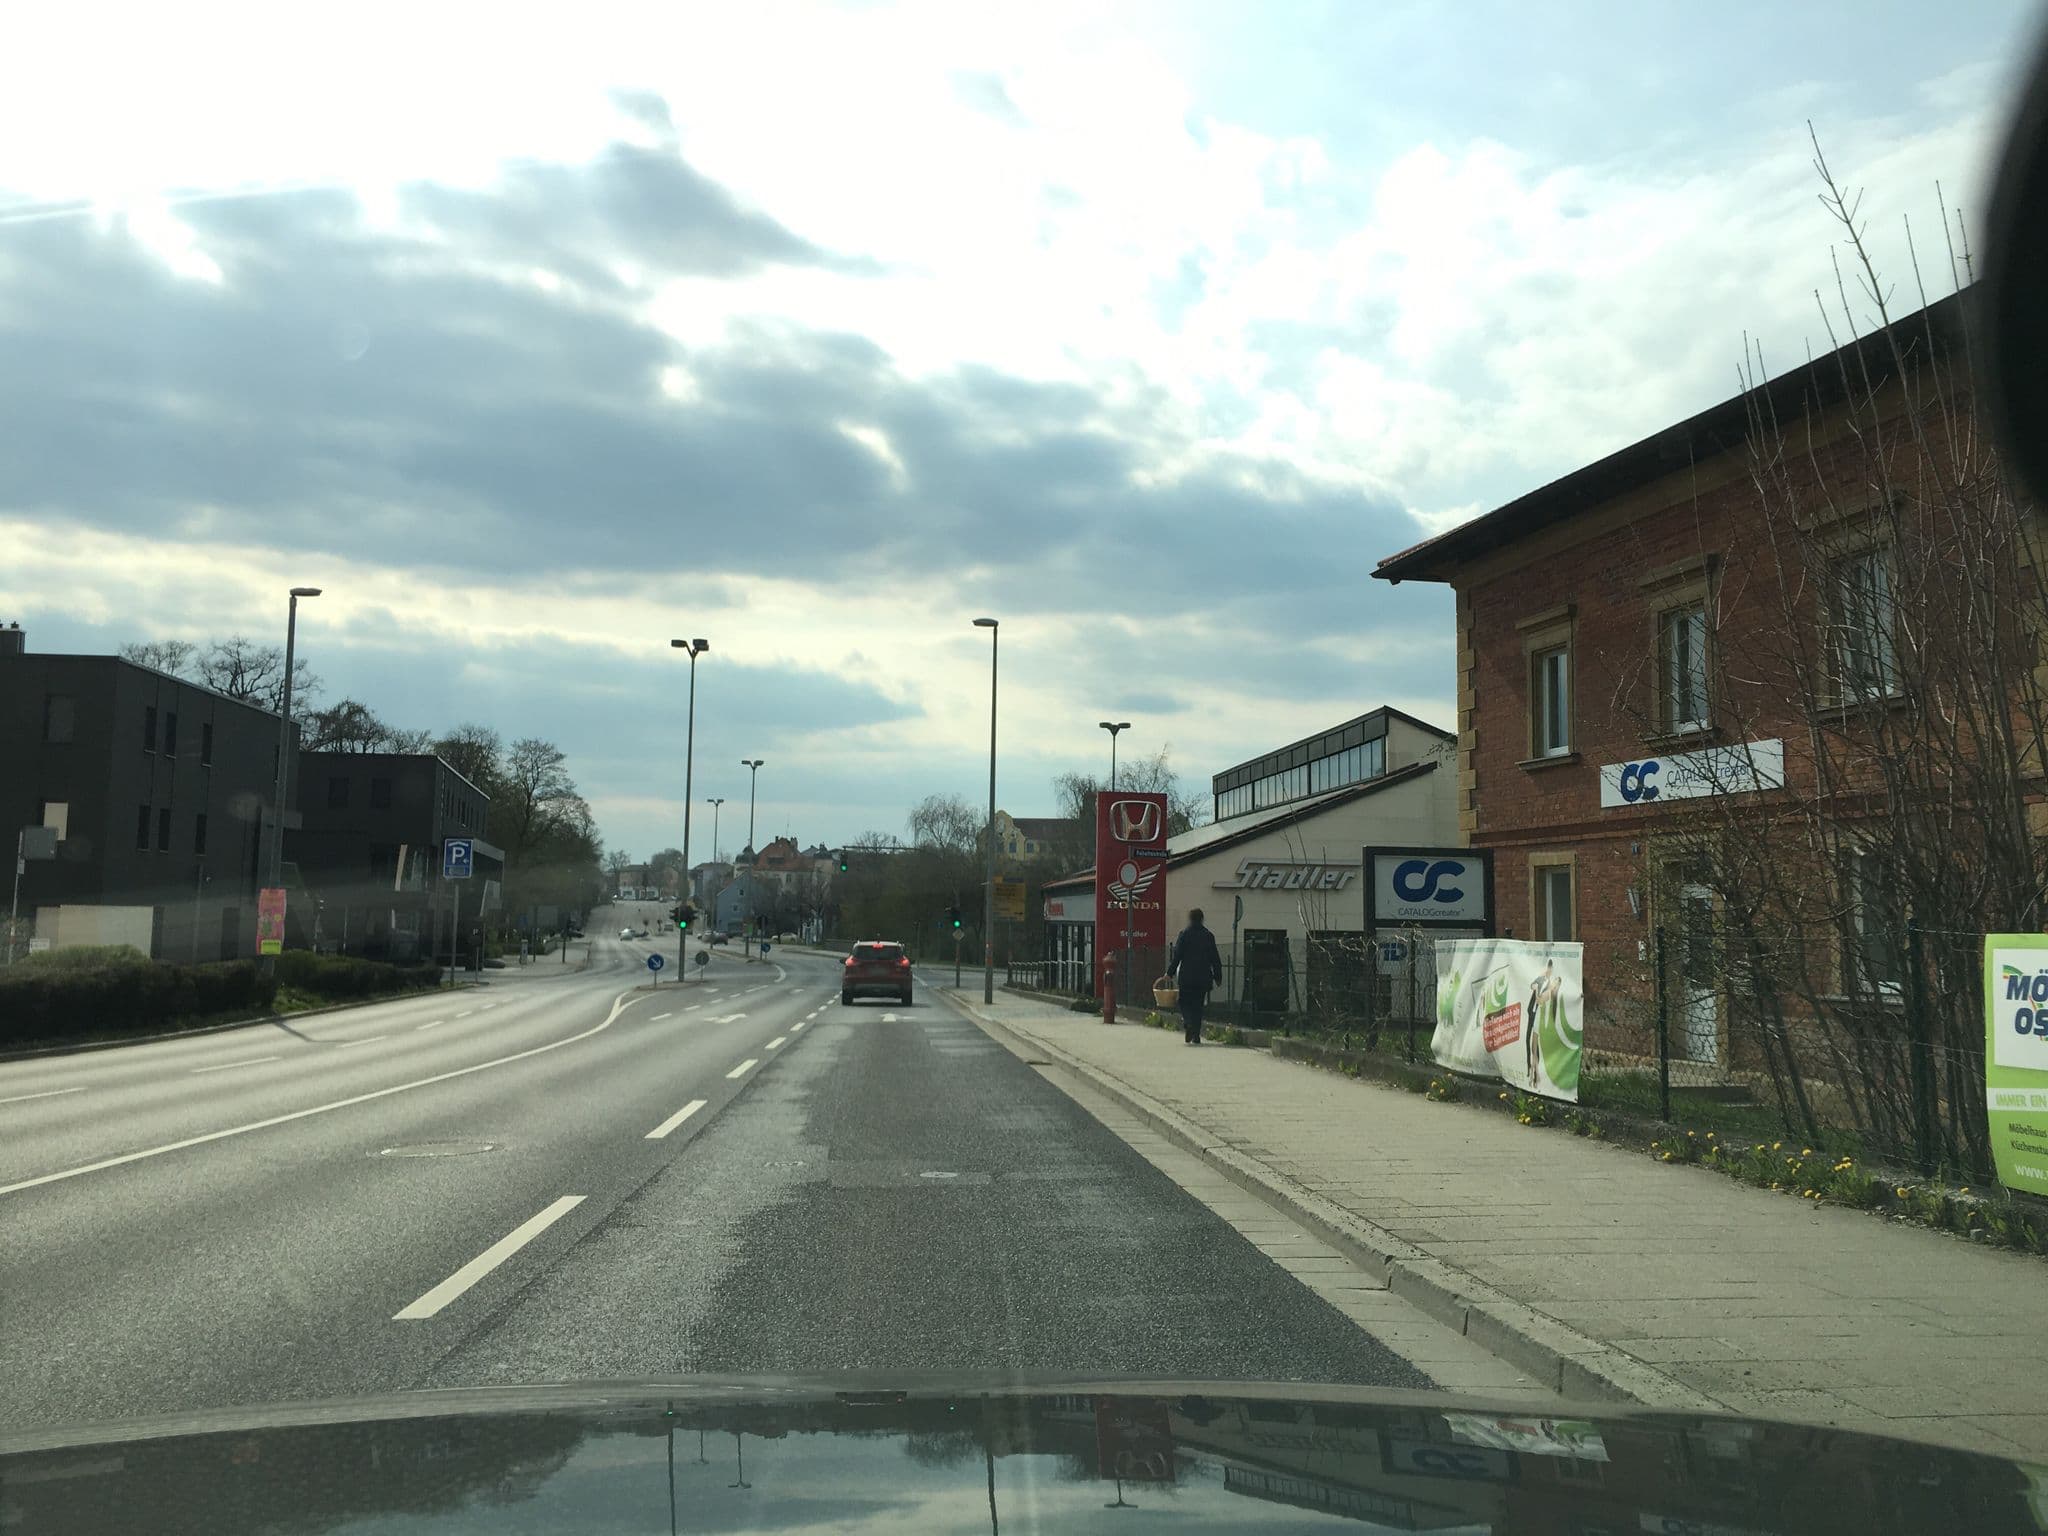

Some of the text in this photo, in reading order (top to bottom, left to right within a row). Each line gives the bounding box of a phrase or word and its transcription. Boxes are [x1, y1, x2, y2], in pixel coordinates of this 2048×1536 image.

[452, 847, 466, 865] P
[1212, 856, 1358, 889] Stadler
[1119, 929, 1149, 938] Stdler
[2014, 1163, 2048, 1181] www.
